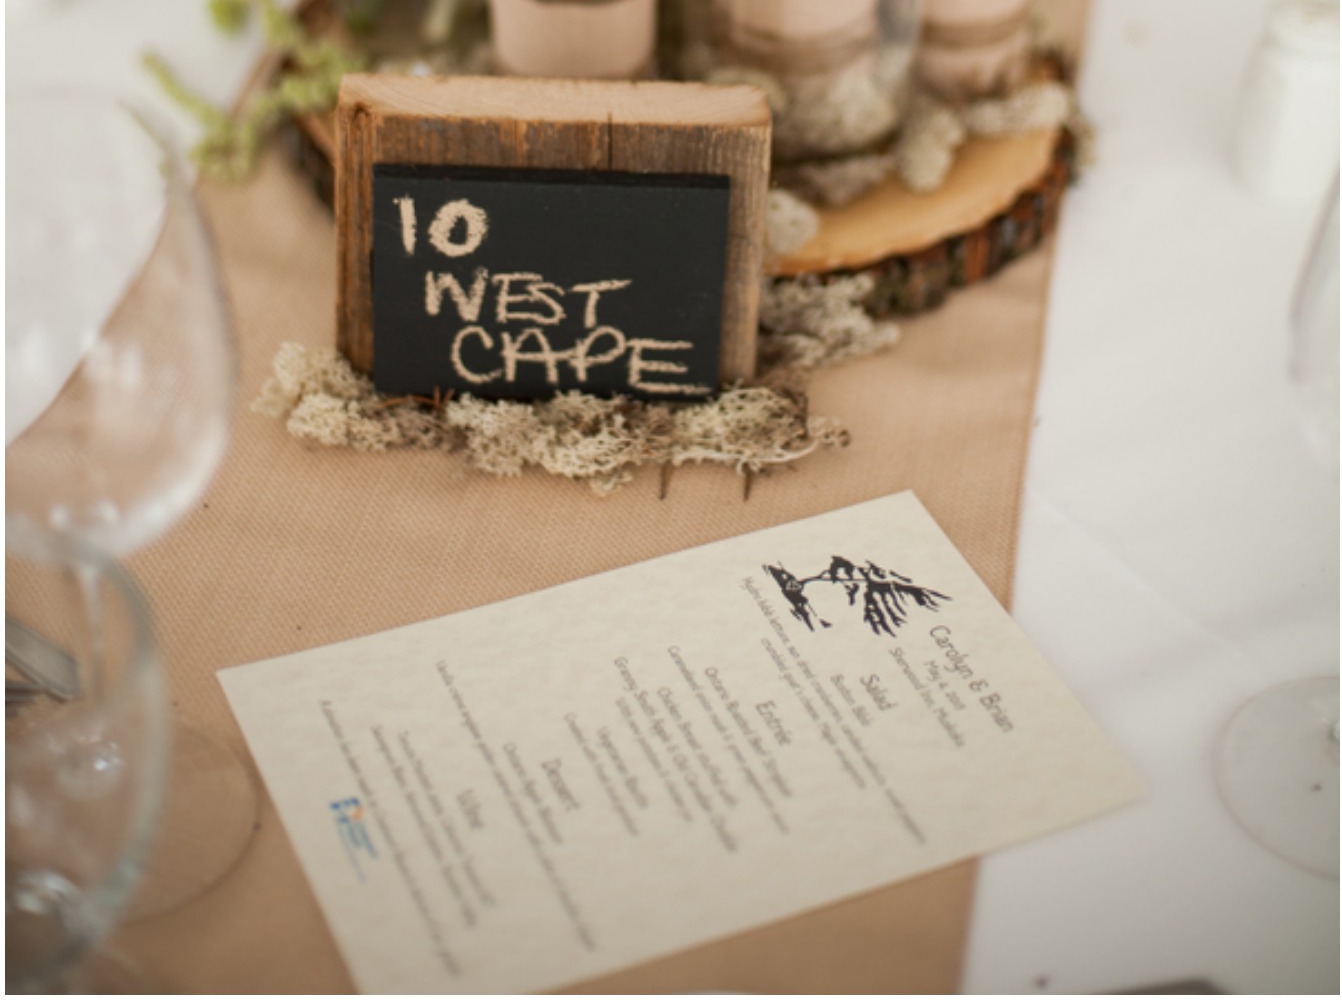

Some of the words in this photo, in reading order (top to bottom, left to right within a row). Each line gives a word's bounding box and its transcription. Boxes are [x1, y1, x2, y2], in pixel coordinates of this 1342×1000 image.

[392, 194, 490, 258] 10
[423, 267, 632, 330] WEST
[449, 325, 713, 395] CAPE
[859, 673, 898, 712] Salad
[929, 625, 974, 679] Carolyn
[968, 678, 990, 693] &
[979, 692, 1014, 733] Brian
